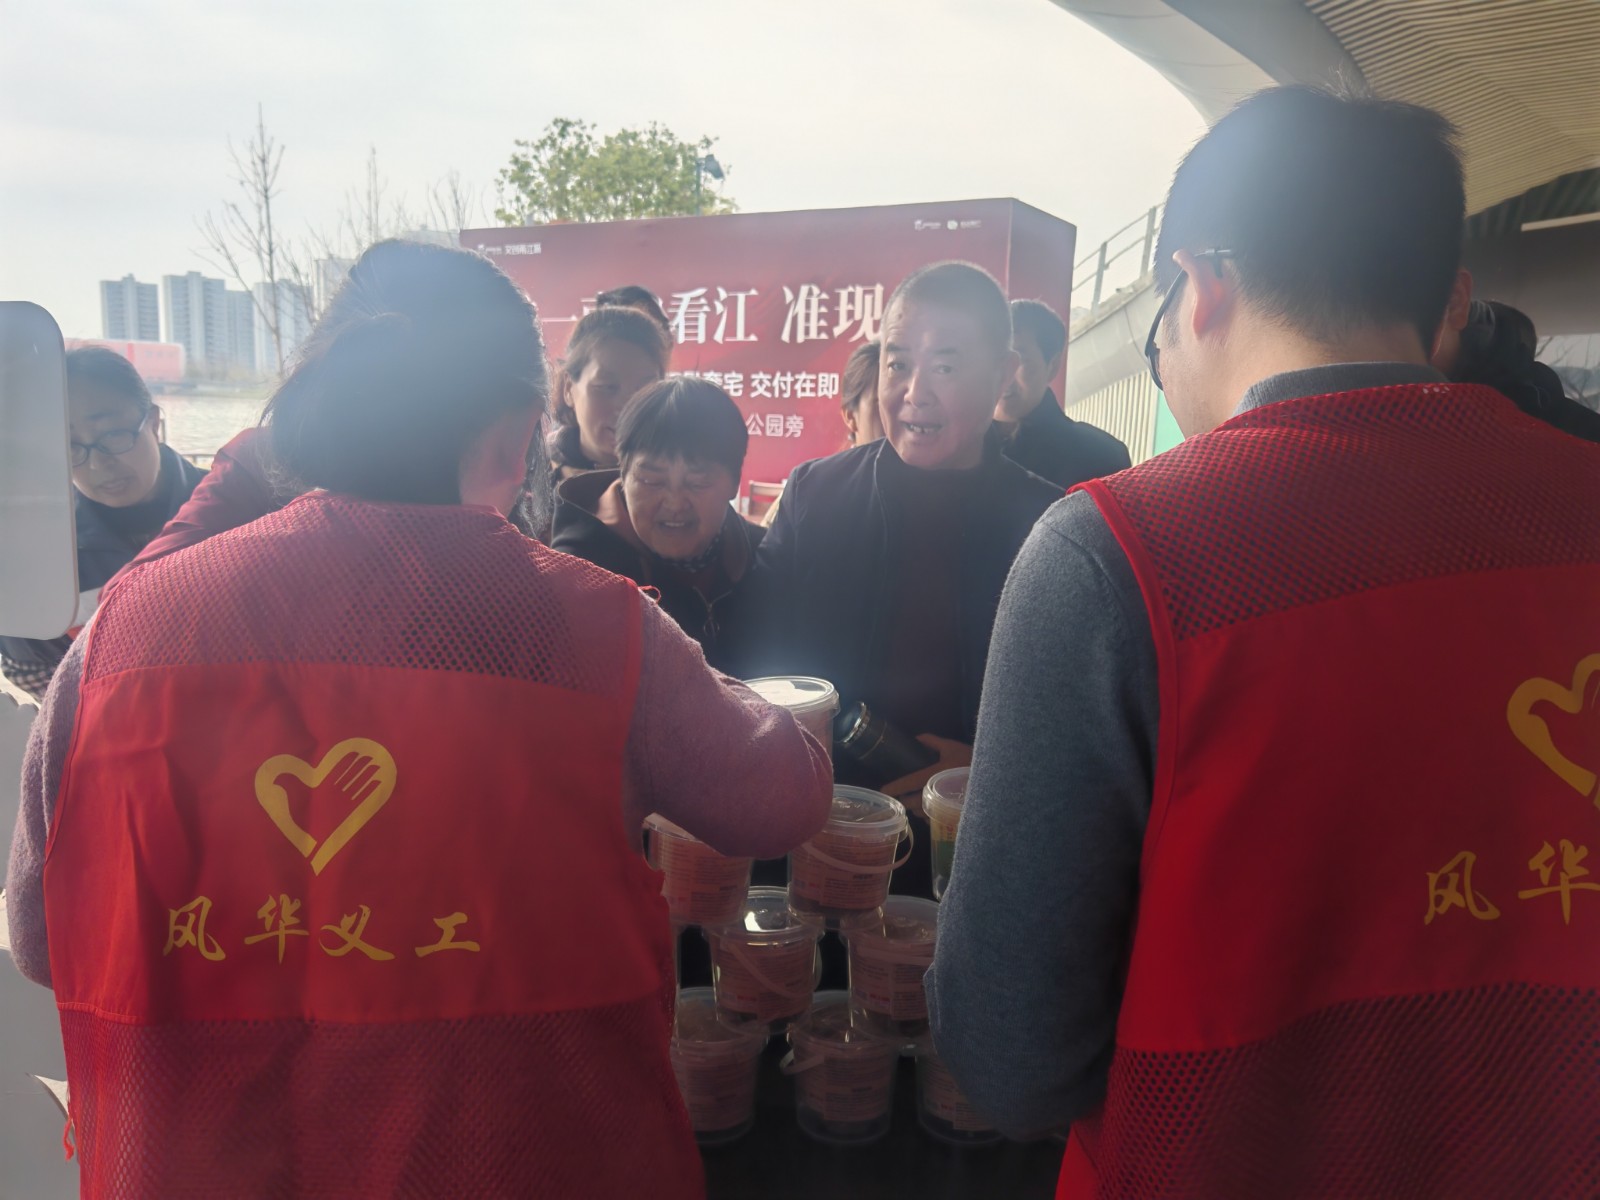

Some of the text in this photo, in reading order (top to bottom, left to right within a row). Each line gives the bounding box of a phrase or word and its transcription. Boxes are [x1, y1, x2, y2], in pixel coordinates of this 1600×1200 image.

[780, 284, 885, 344] 准现
[751, 371, 839, 398] 交付在即
[745, 413, 804, 438] 公园旁
[1424, 839, 1600, 925] 风华
[163, 894, 480, 964] 风华义工
